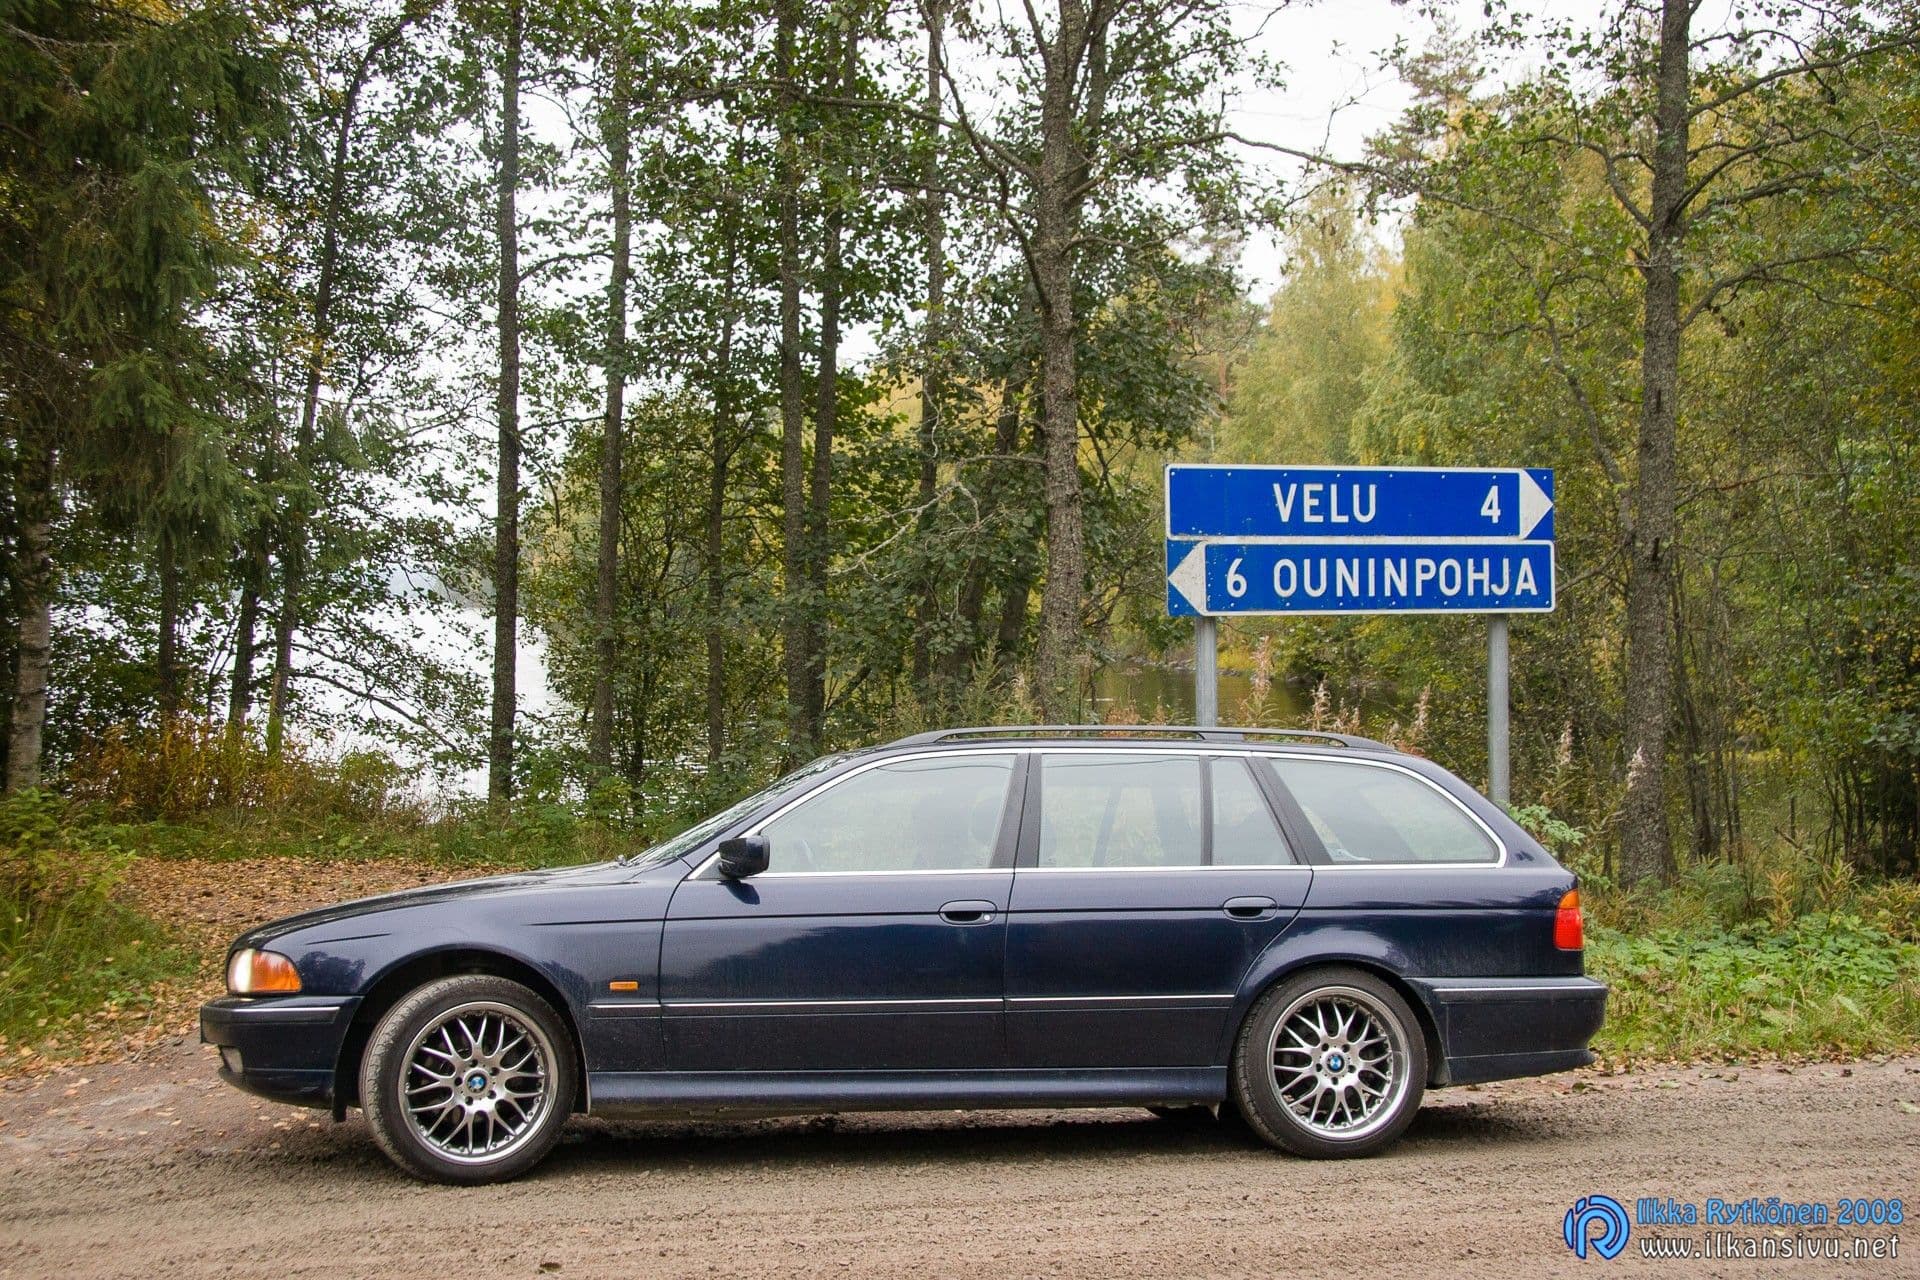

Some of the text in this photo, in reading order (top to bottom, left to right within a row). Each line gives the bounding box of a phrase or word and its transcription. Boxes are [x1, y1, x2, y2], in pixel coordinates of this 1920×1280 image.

[1273, 483, 1501, 524] VELU 4
[1226, 557, 1538, 598] 6 OUNINPOHJA
